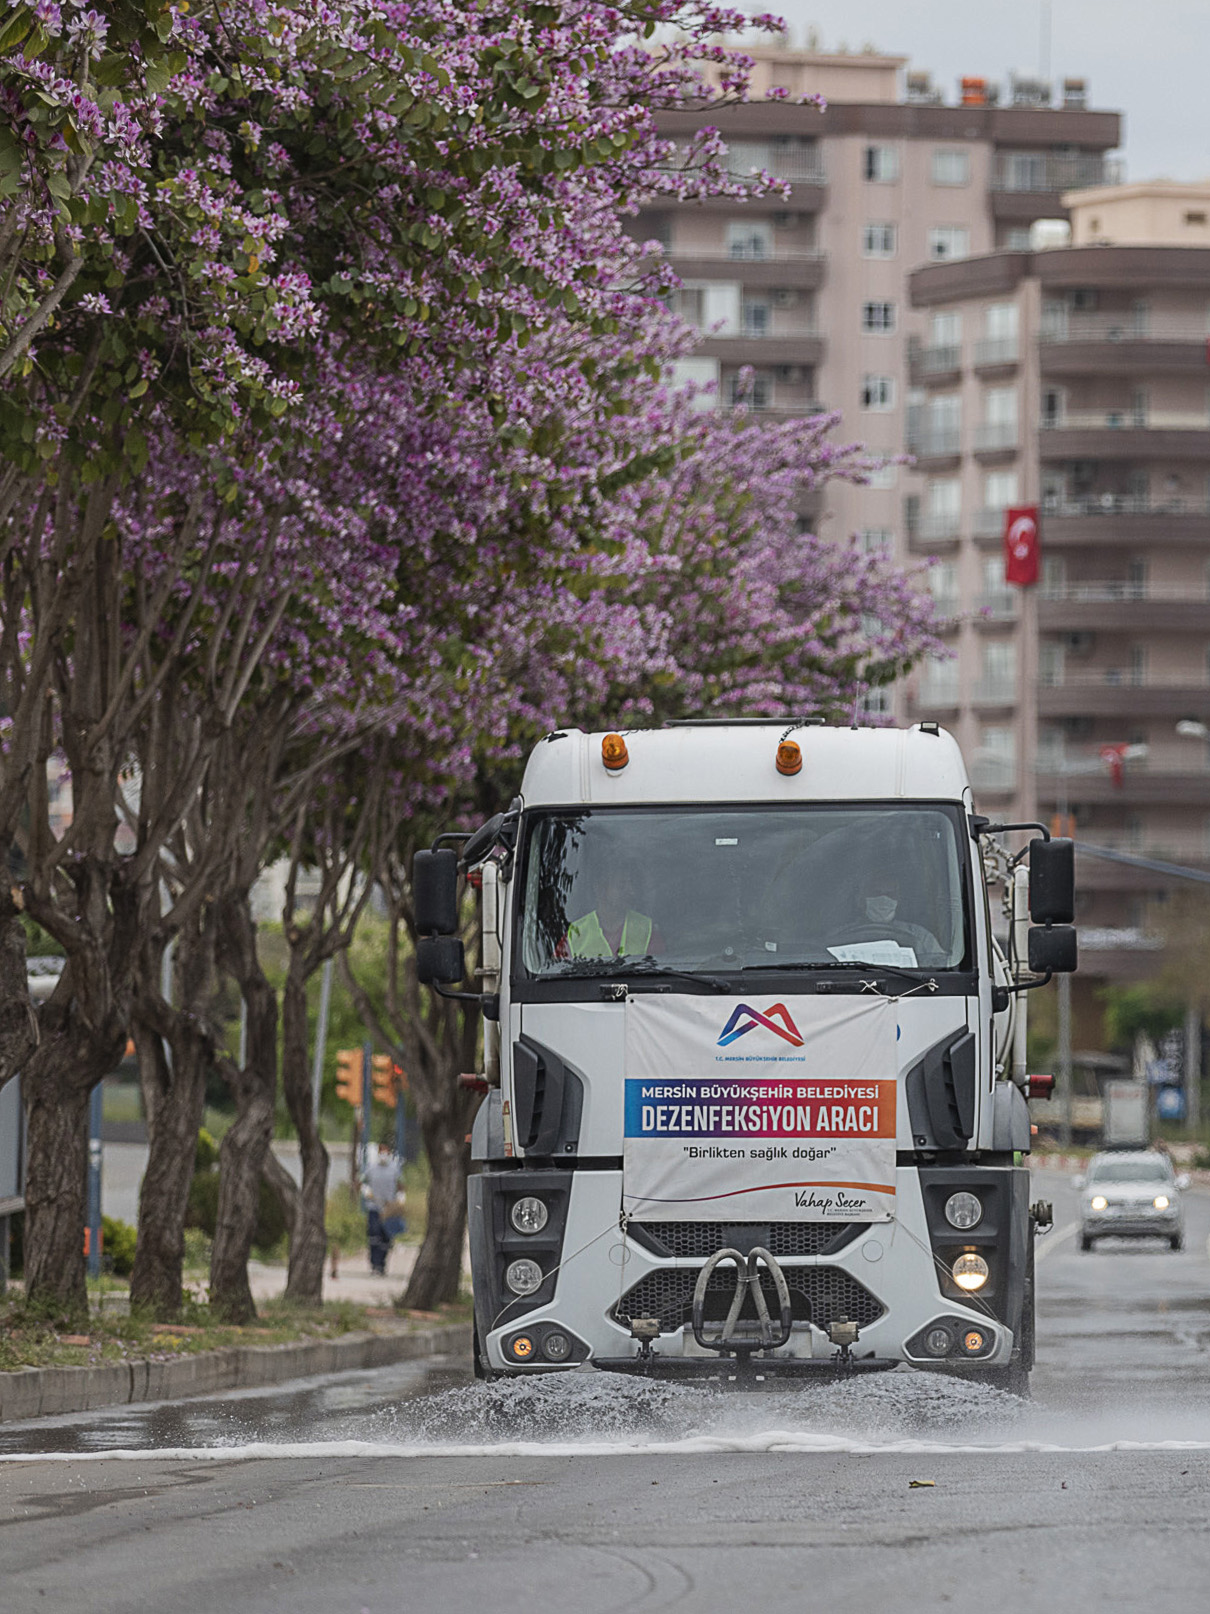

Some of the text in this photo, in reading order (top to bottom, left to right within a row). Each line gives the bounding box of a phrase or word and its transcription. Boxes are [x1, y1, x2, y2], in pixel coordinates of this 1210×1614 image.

[641, 1083, 879, 1101] MERSİN BÜYÜKŞEHİR BELEDİYESİ
[816, 1105, 879, 1132] ARACI
[683, 1146, 837, 1161] "Birlikten sağlık doğar"
[794, 1190, 833, 1215] Vahap
